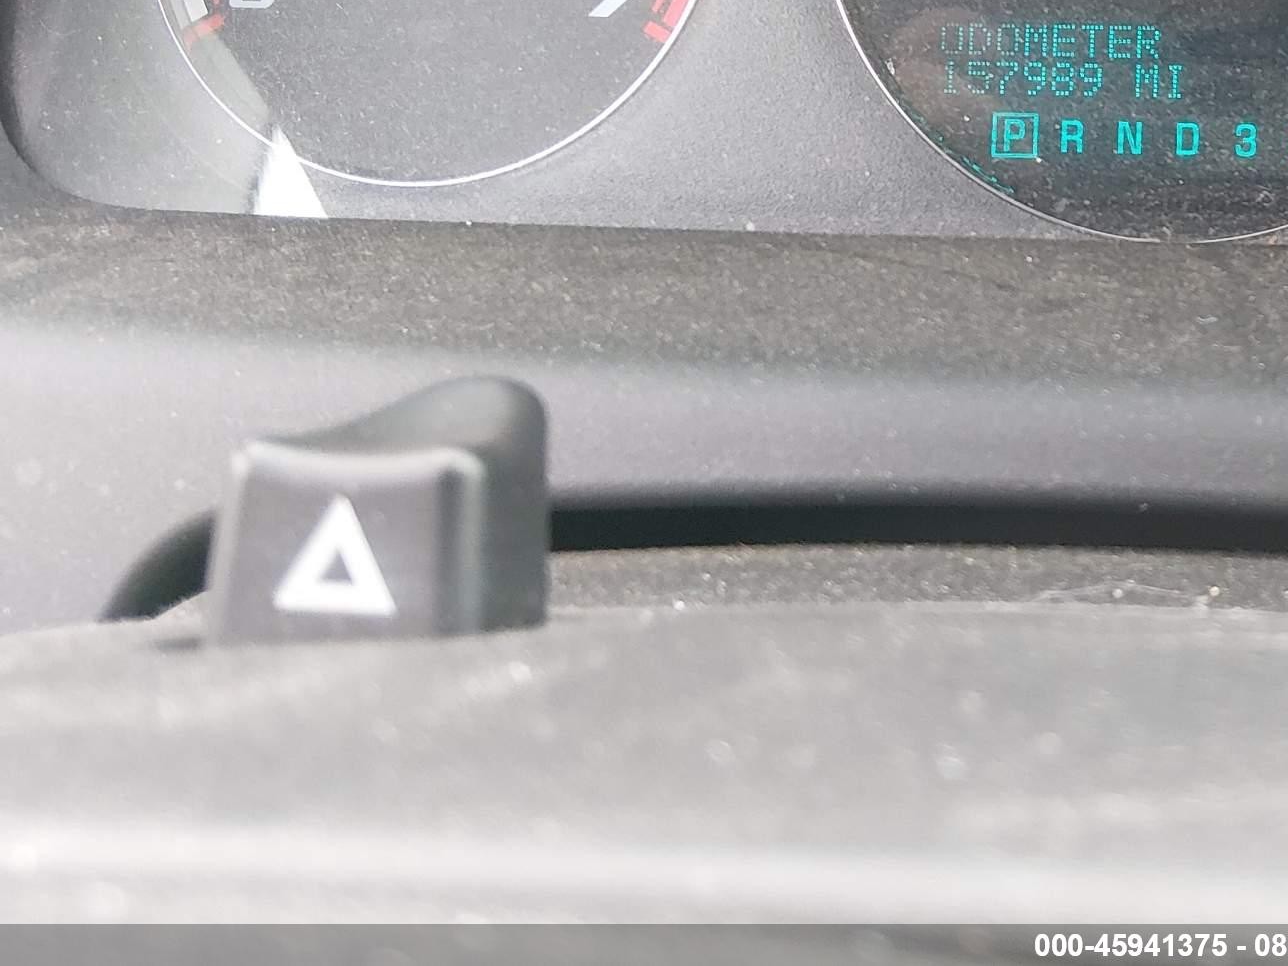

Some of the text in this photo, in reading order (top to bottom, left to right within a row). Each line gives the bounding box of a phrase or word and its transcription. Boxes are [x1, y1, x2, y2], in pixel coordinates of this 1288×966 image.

[941, 23, 1162, 59] ODOMETER
[943, 60, 1183, 99] 157989 MI
[1003, 118, 1027, 153] P
[1060, 120, 1084, 154] R
[1116, 121, 1143, 155] N
[1175, 122, 1200, 156] D
[1234, 123, 1258, 158] 3
